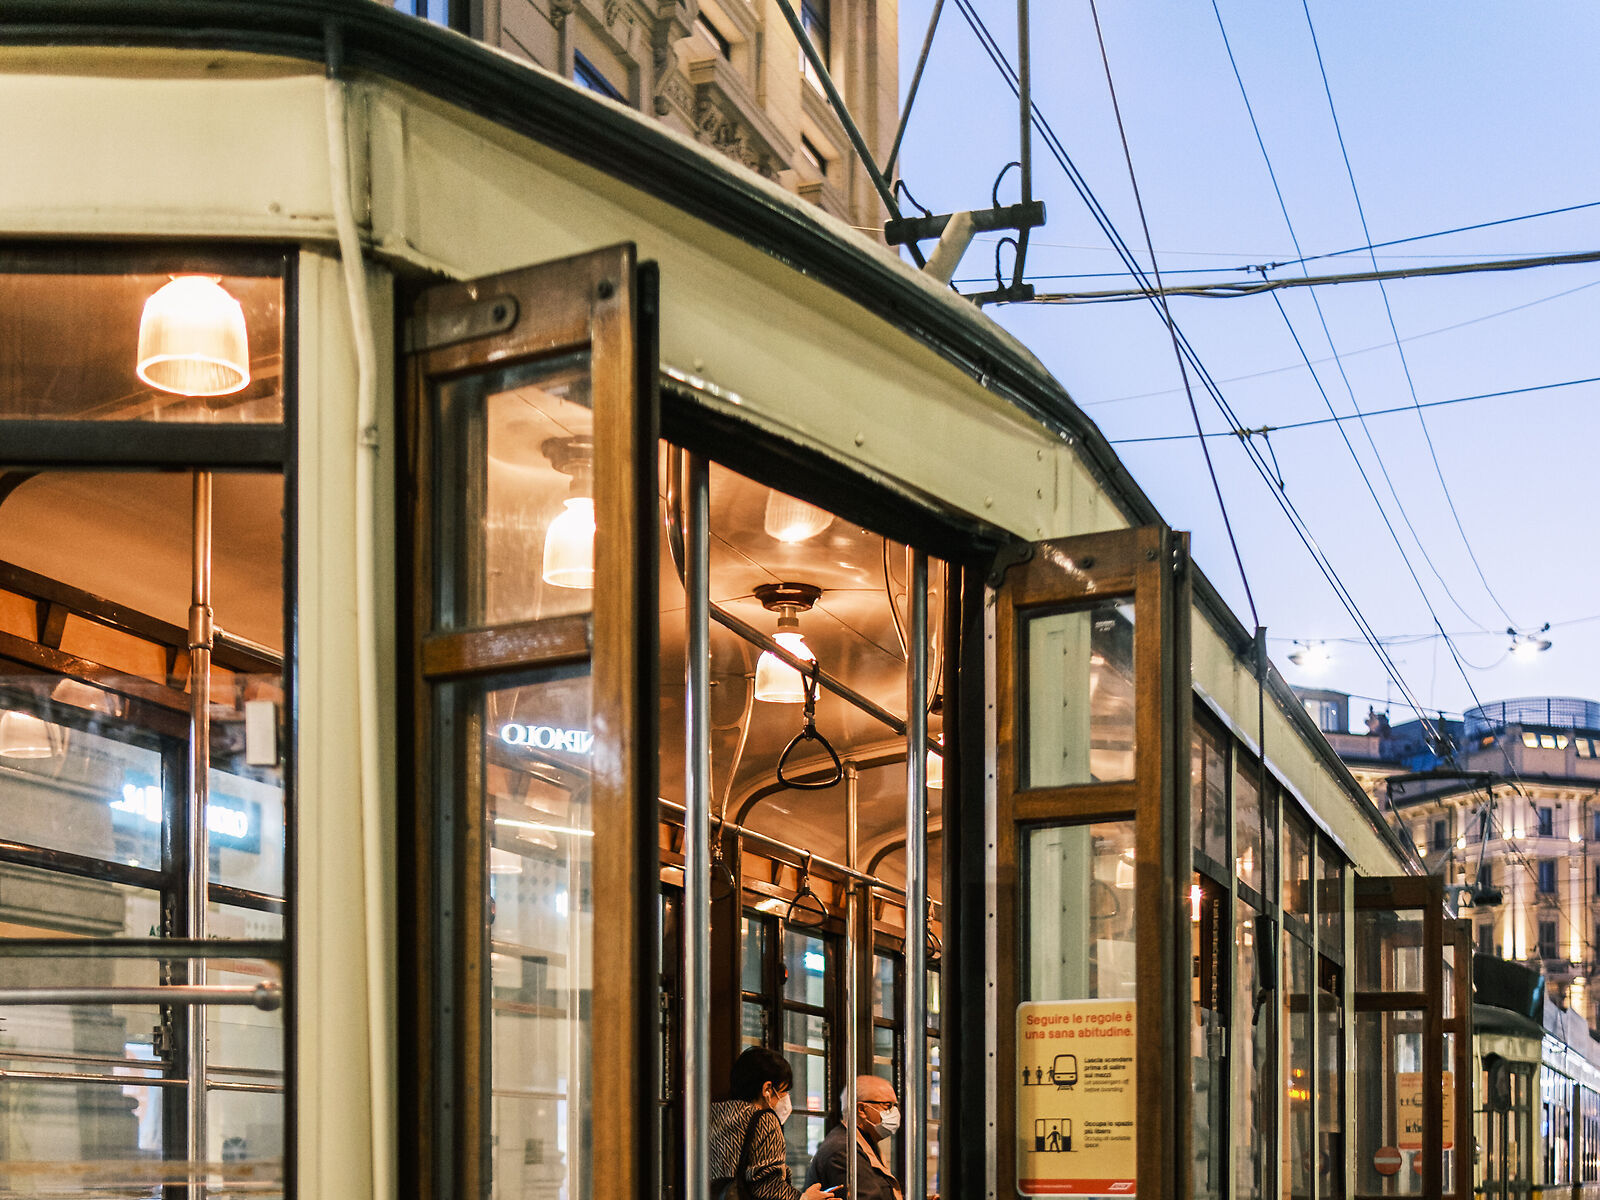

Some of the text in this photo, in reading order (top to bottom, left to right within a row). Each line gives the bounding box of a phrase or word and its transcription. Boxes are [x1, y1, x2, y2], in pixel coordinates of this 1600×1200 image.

[1026, 1010, 1132, 1026] Seguire le regole è
[1025, 1027, 1134, 1040] una sana abitudine.
